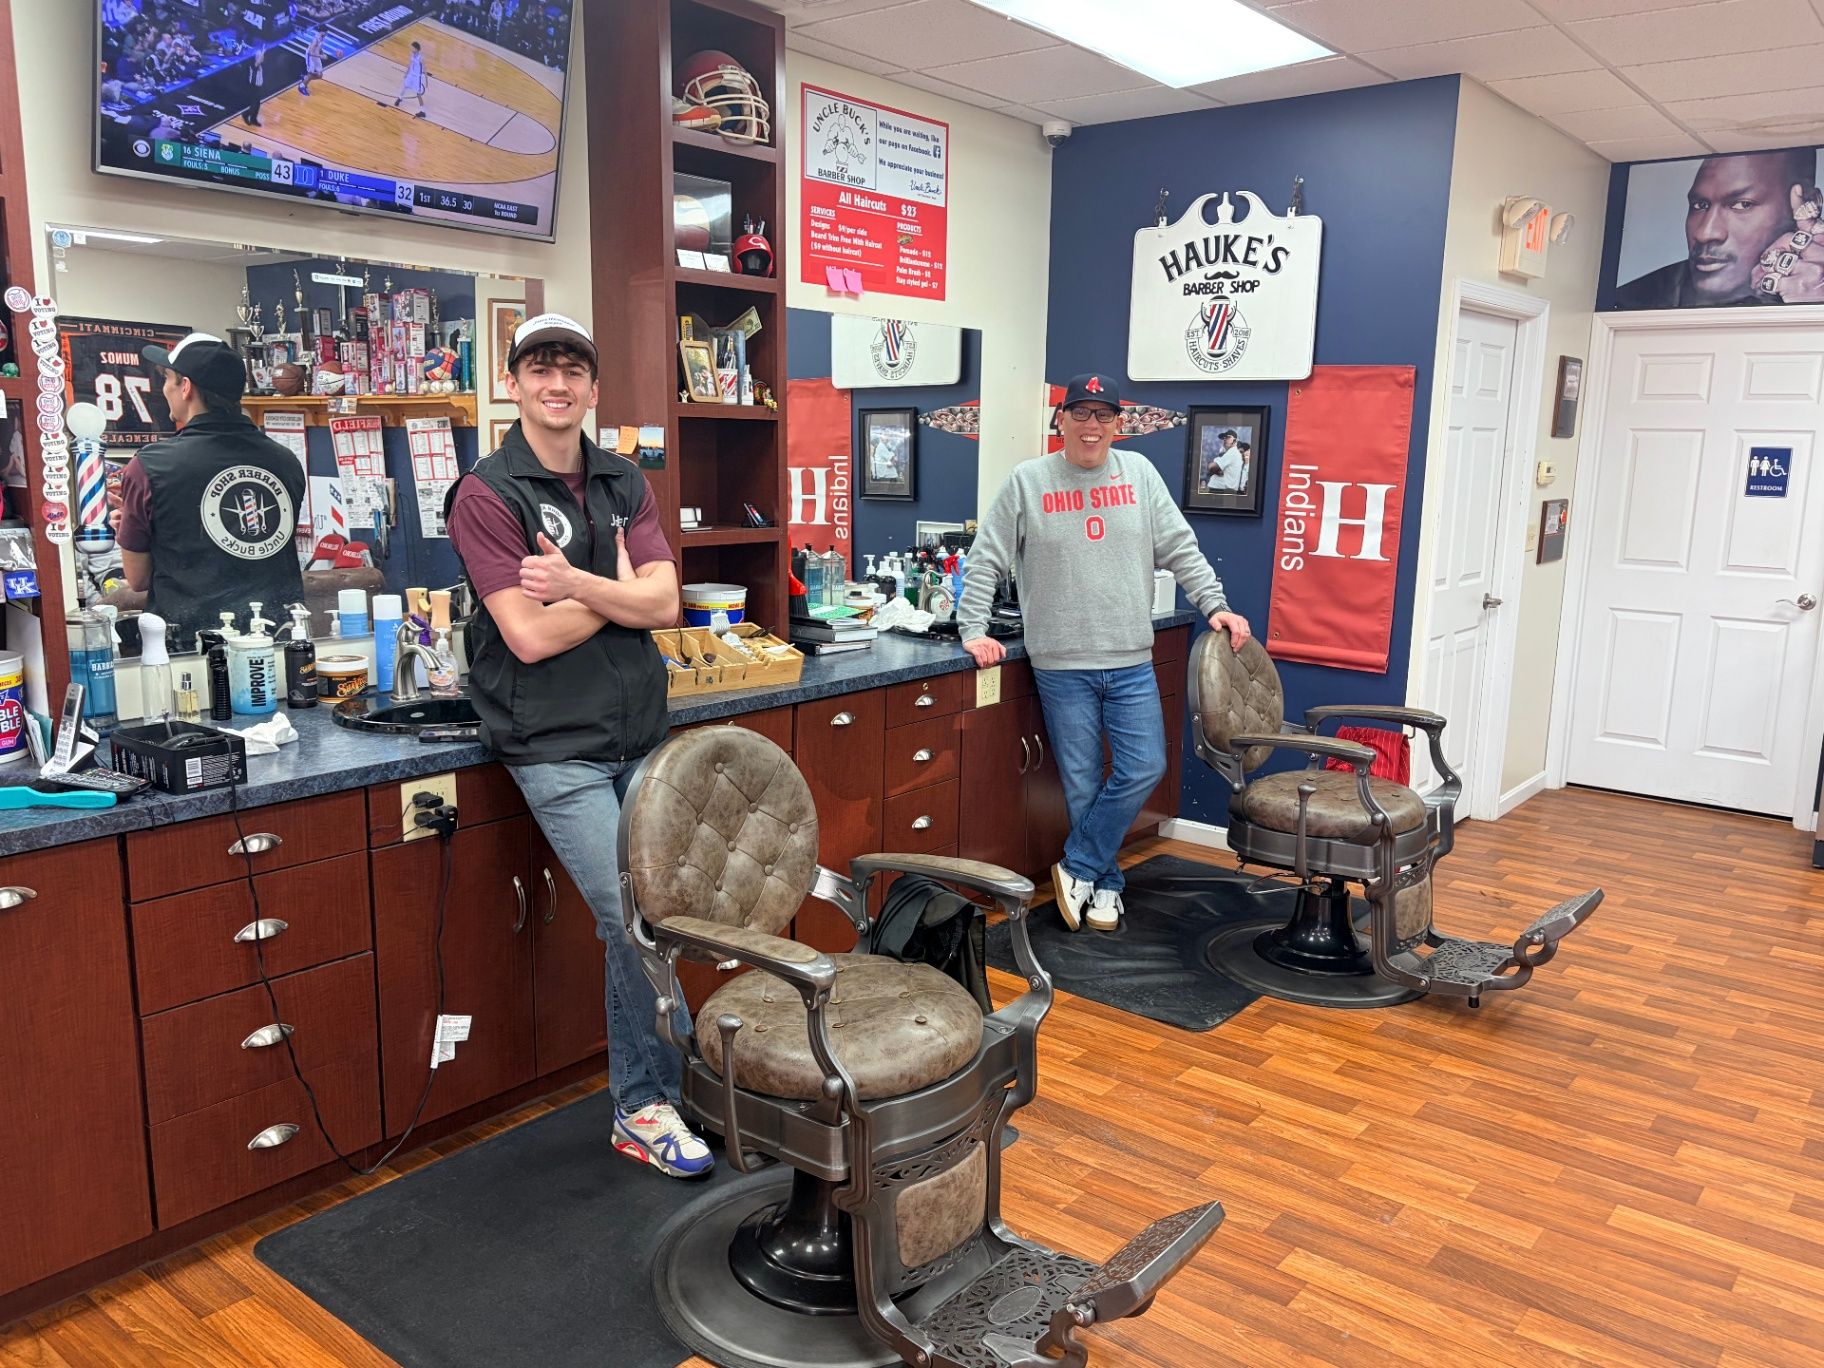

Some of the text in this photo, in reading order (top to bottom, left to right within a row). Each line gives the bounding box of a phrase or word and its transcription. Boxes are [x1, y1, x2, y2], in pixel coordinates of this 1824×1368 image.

[812, 102, 871, 145] UNCLE BUCK'S
[183, 146, 221, 161] 16 SIENA
[220, 166, 240, 177] BONUS
[255, 171, 270, 182] POSS
[274, 164, 291, 180] 43
[328, 171, 350, 183] DUKE
[817, 168, 866, 185] BARBER SHOP
[397, 186, 412, 200] 32
[419, 192, 431, 203] 1ST
[440, 195, 457, 207] 36.5
[462, 200, 473, 210] 30
[839, 191, 851, 205] All
[853, 193, 887, 212] Haircuts
[810, 205, 836, 218] SERVICES
[896, 221, 922, 234] PRODUCTS
[1158, 234, 1290, 283] HAUKE'S
[1183, 279, 1261, 296] BARBER SHOP
[1189, 339, 1246, 371] HAIRCUTS SHAVES
[1042, 484, 1137, 514] OHIO STATE
[1279, 463, 1319, 571] Indians
[1308, 480, 1398, 562] H
[249, 658, 267, 707] IMPROVE
